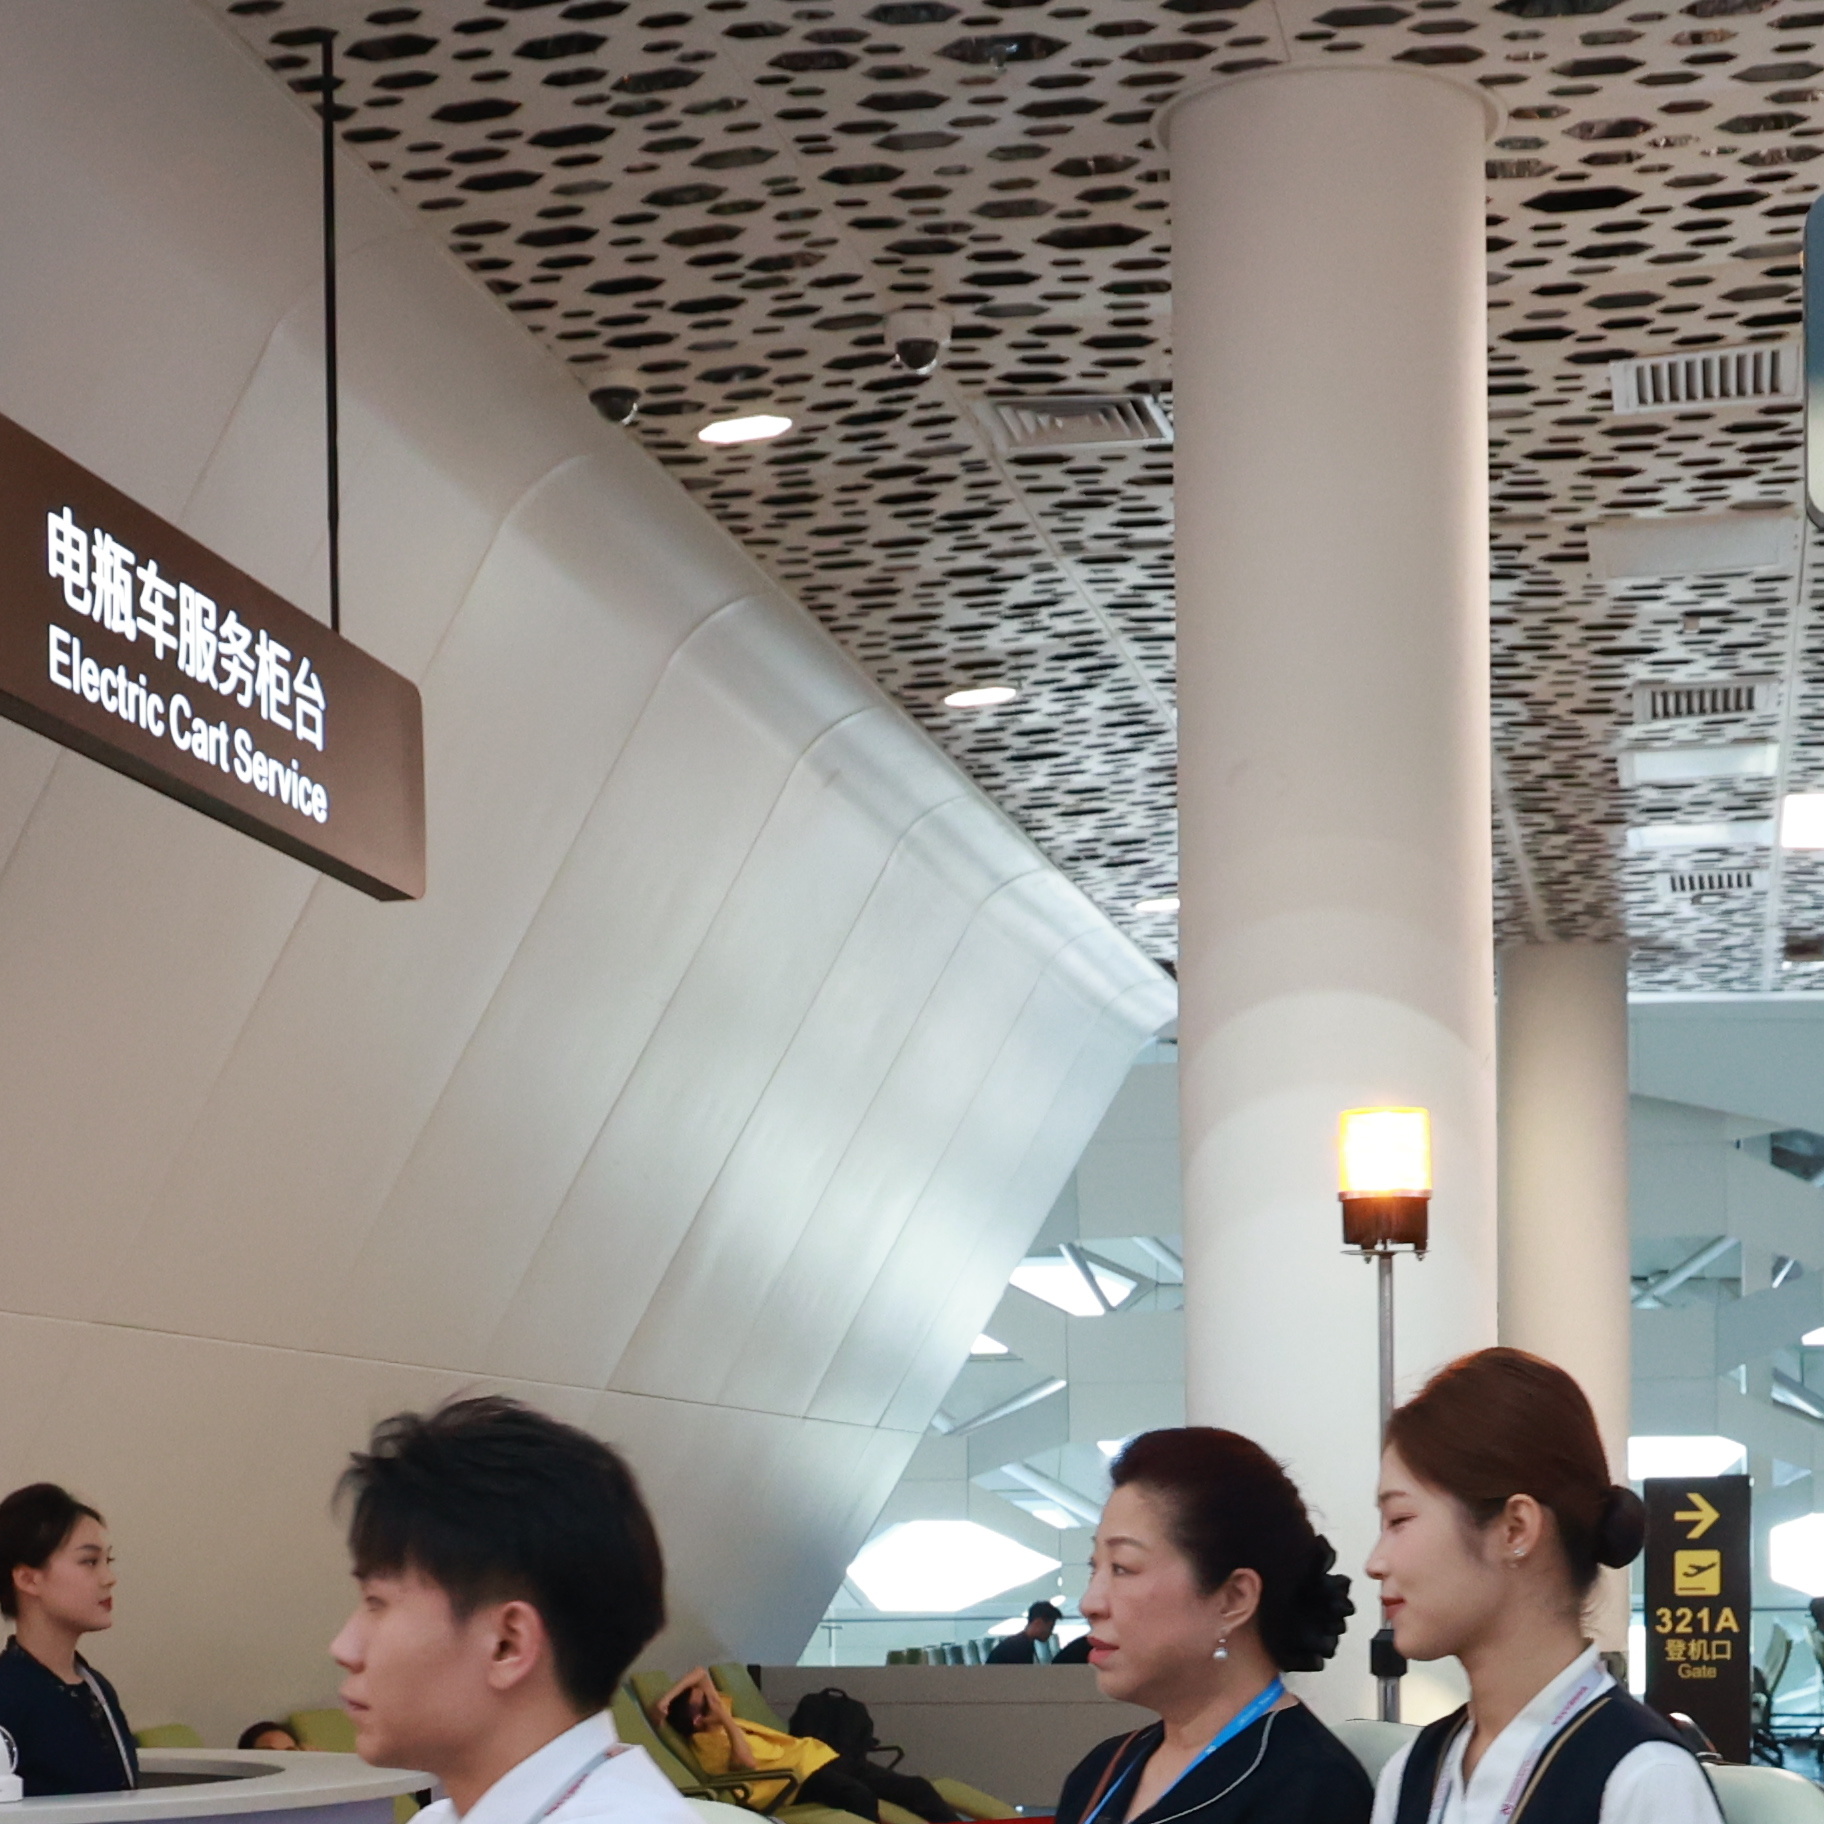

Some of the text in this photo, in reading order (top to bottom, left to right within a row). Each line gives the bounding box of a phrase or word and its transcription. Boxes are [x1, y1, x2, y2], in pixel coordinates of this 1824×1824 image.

[47, 506, 326, 751] 电瓶车服务柜台
[48, 624, 329, 823] Electric Cart Service
[1655, 1606, 1741, 1635] 321A
[1665, 1639, 1732, 1662] 登机口
[1678, 1663, 1717, 1679] Gate
